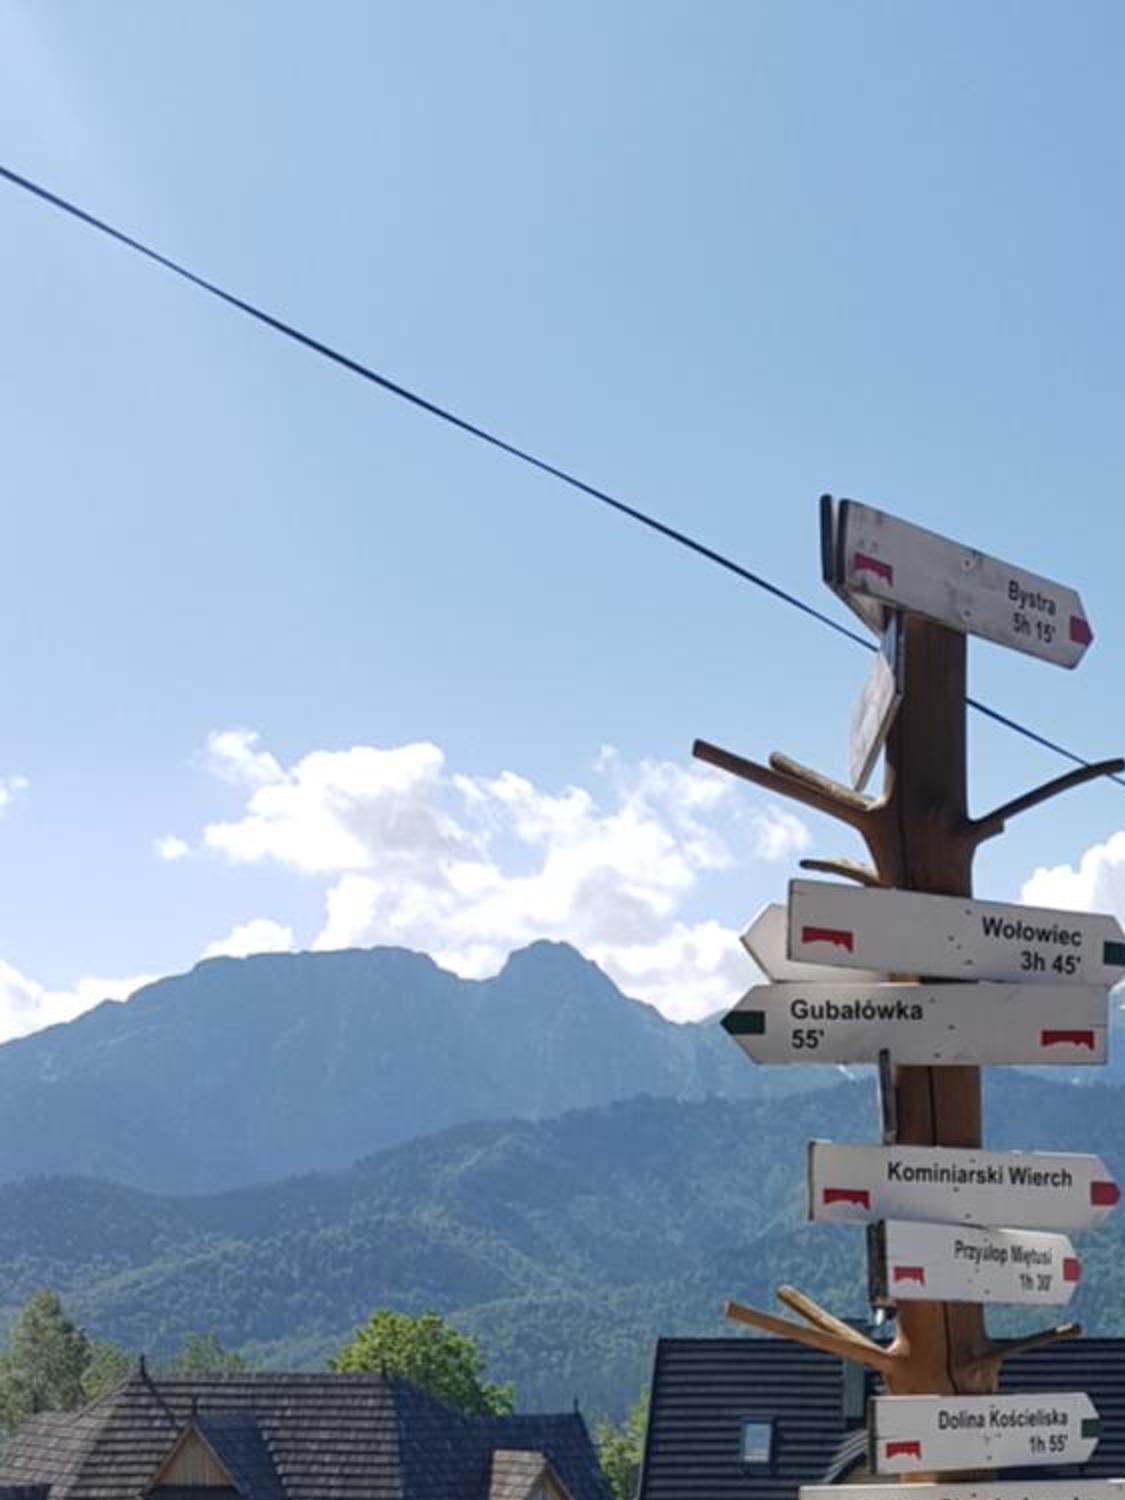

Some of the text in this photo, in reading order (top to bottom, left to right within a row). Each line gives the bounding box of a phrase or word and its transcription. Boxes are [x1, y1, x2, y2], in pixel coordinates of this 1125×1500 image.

[1008, 579, 1056, 617] Bystra
[1013, 612, 1056, 643] 5h 15'
[1020, 950, 1081, 975] 3h 45'
[790, 998, 923, 1020] Gubałówka
[791, 1028, 824, 1049] 55'
[887, 1162, 1073, 1187] Kominiarski Wierch
[1020, 1273, 1034, 1290] 1h
[938, 1407, 1068, 1430] Dolina Kościeliska
[1029, 1434, 1068, 1453] 1h 55'
